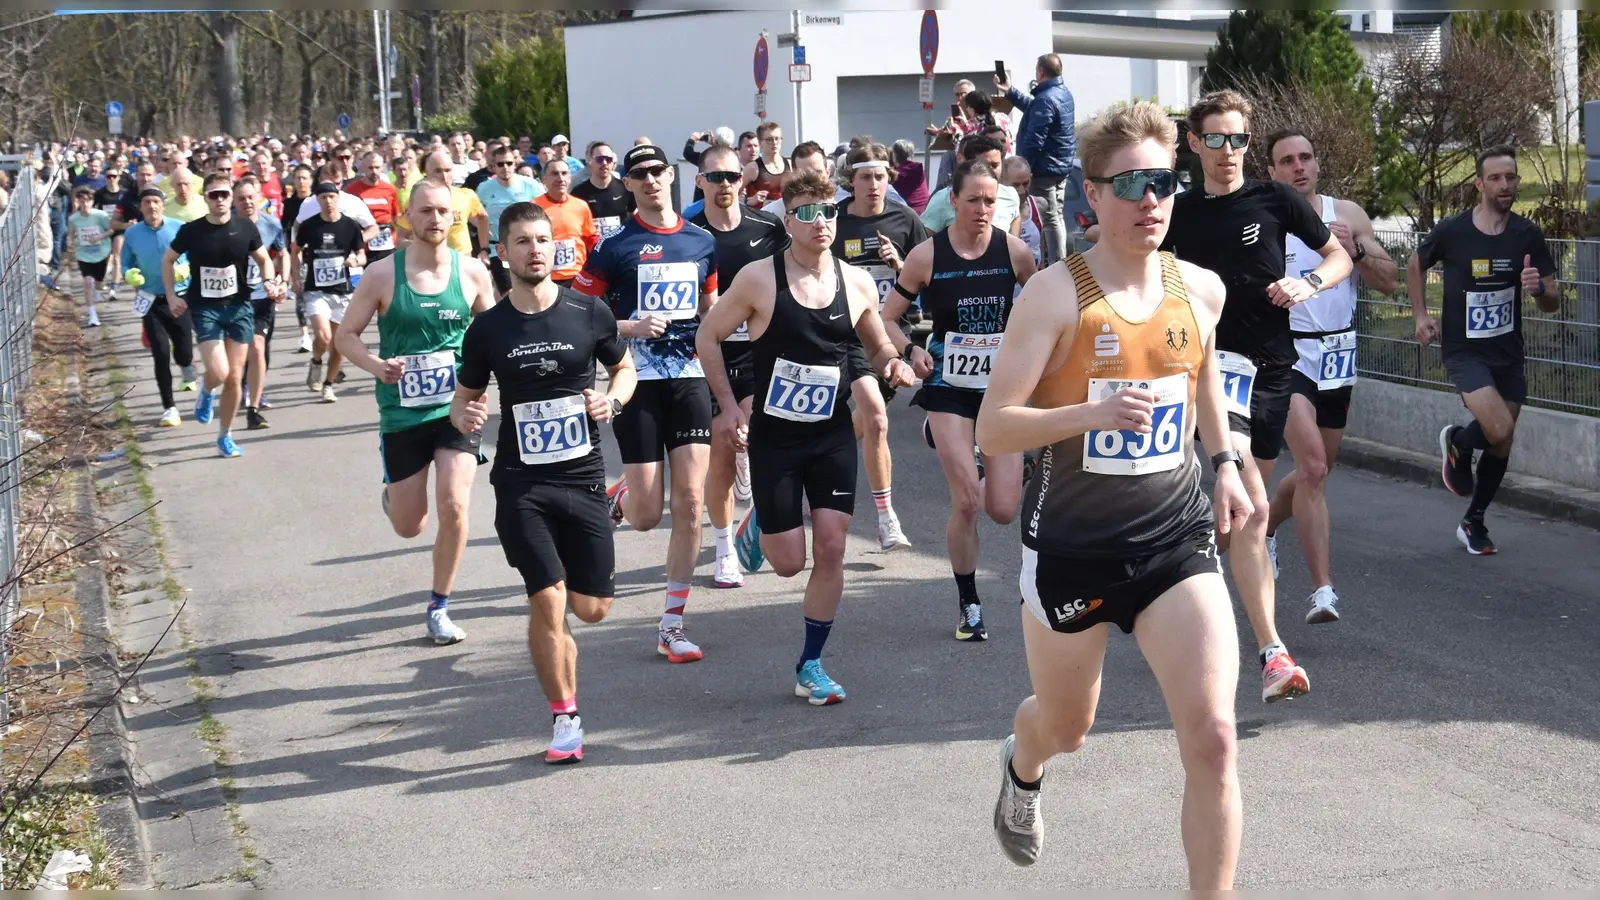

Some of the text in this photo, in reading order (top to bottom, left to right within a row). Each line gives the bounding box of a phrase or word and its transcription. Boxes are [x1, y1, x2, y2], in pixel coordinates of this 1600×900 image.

[806, 15, 841, 25] Birkenweg
[554, 247, 574, 265] 85
[248, 265, 260, 279] 9
[318, 267, 342, 282] 657
[644, 282, 693, 310] 662
[957, 296, 998, 306] ABSOLUTE
[438, 309, 458, 320] TSV
[957, 305, 998, 322] RUN
[1471, 304, 1511, 330] 938
[958, 321, 996, 333] CREW
[963, 336, 1001, 346] SAS
[507, 342, 574, 358] SonderBar
[947, 353, 992, 376] 1224
[1090, 359, 1124, 367] Sparkasse
[404, 367, 452, 397] 852
[775, 380, 830, 414] 769
[524, 416, 583, 453] 820
[1028, 510, 1041, 539] LSC
[1054, 598, 1086, 621] LSC
